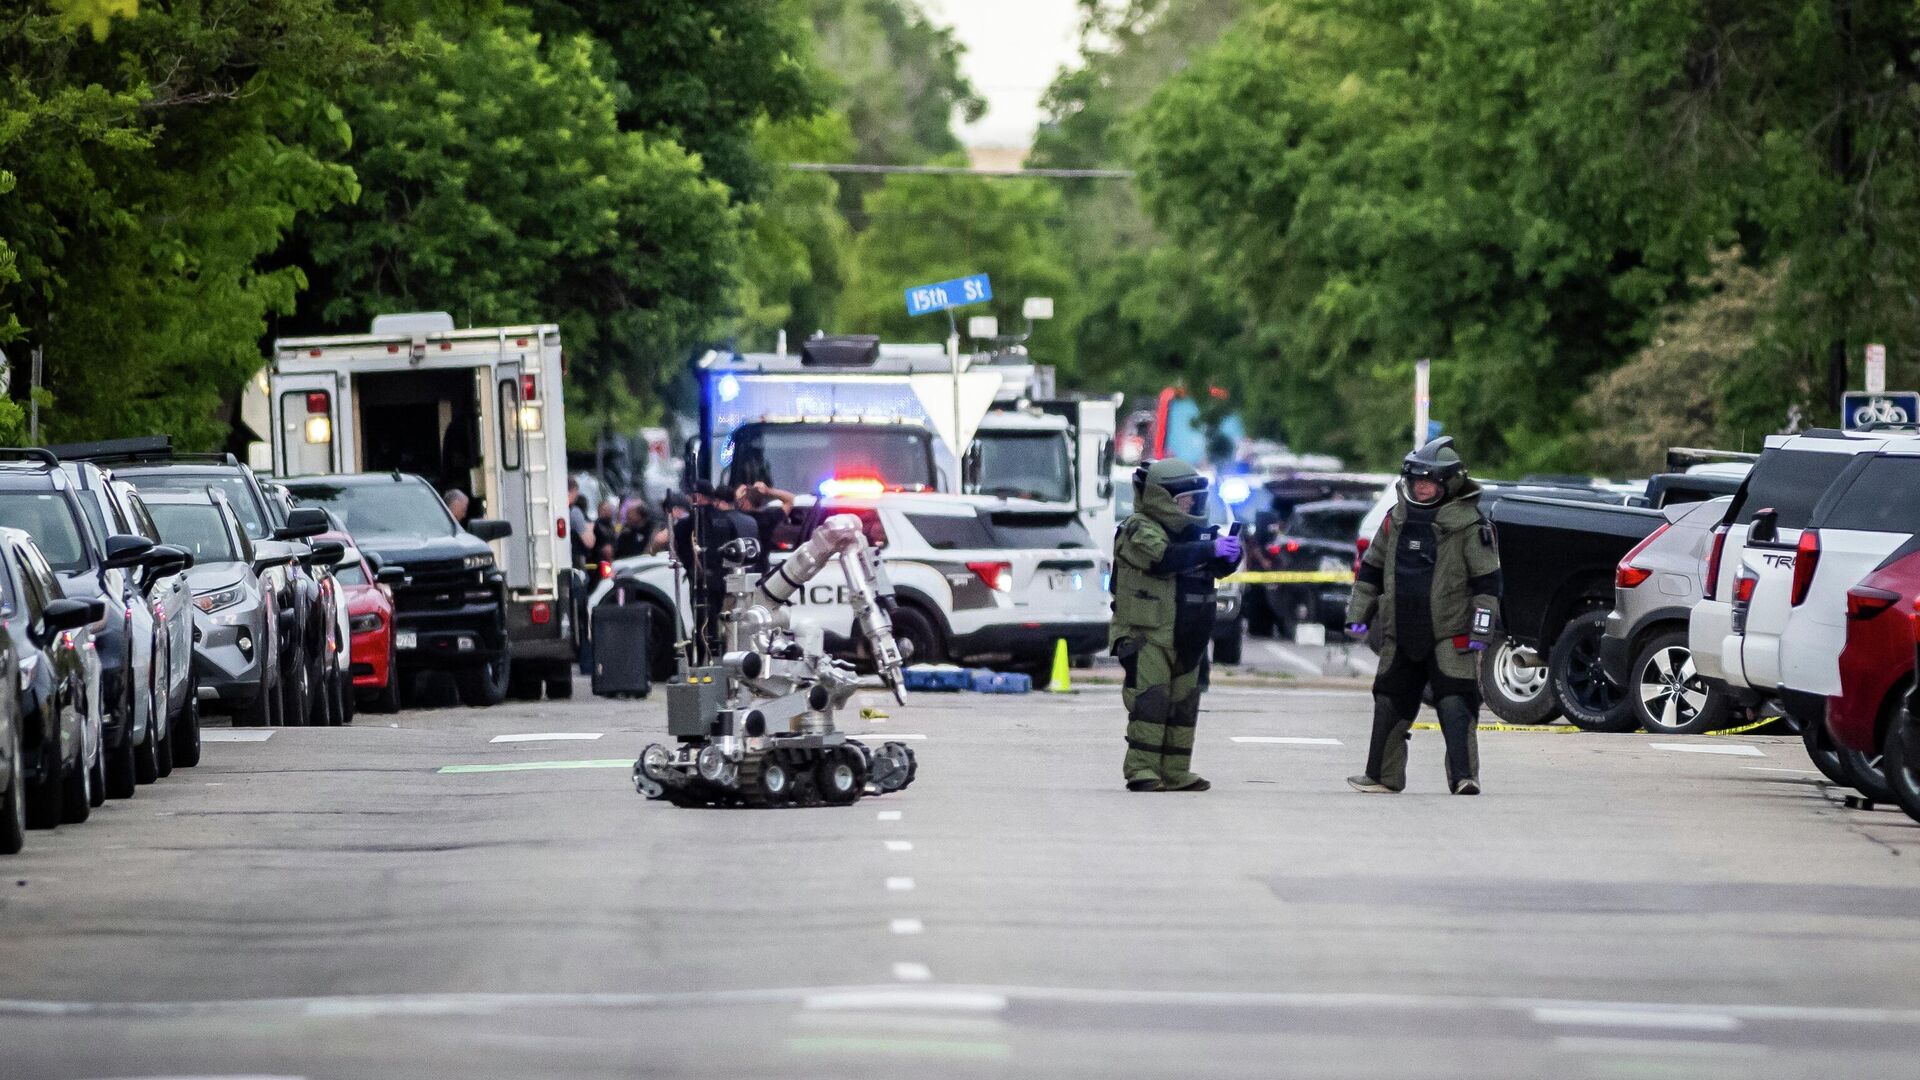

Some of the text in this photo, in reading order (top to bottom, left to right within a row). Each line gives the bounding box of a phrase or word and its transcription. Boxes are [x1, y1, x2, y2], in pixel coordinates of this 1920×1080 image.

[911, 279, 985, 312] 15th St
[797, 584, 850, 605] ICE
